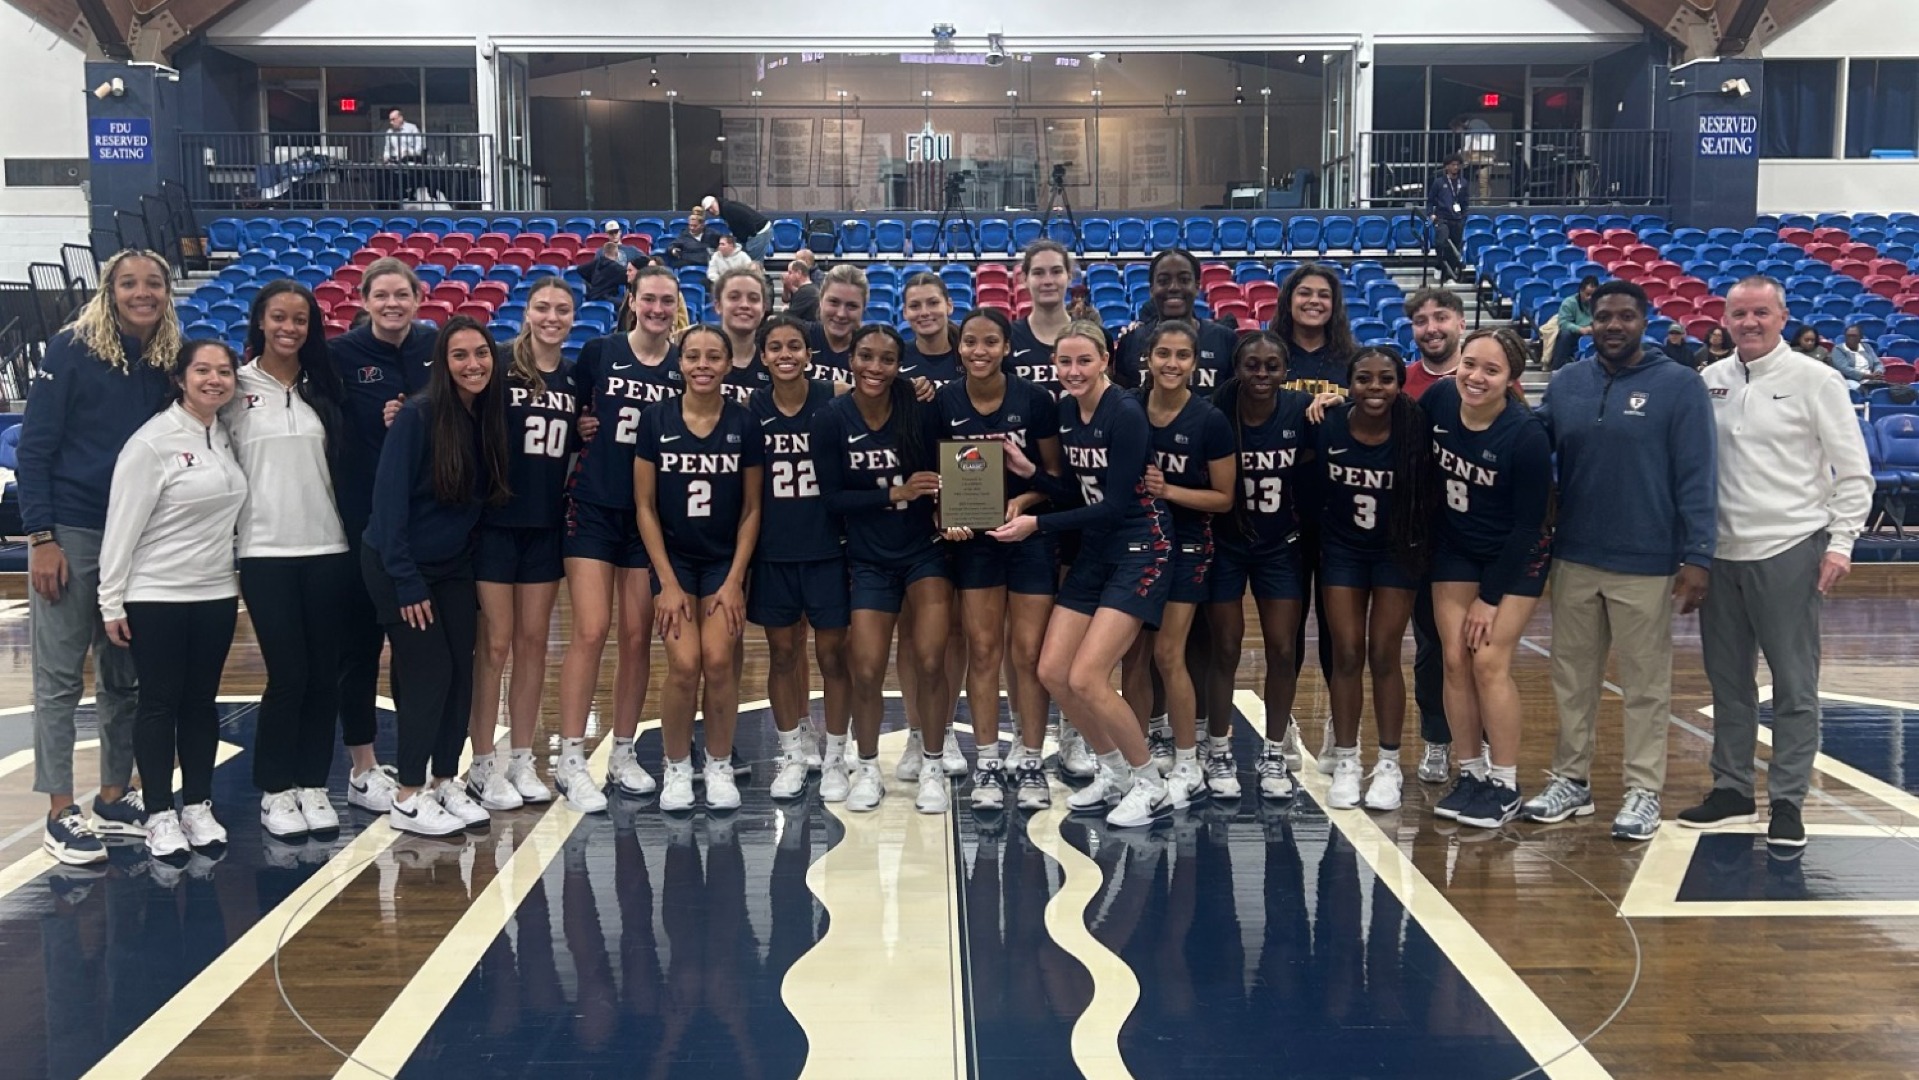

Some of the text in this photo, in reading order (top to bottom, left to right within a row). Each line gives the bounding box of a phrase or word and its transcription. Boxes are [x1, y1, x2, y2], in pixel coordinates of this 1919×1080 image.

[109, 122, 131, 133] FDU
[1699, 115, 1757, 133] RESERVED
[95, 134, 148, 146] RESERVED
[906, 130, 952, 162] FDU
[1701, 136, 1752, 155] SEATING
[99, 147, 144, 159] SEATING
[524, 415, 568, 458] 20
[660, 452, 741, 474] PENN
[1241, 448, 1297, 470] ENN
[772, 460, 820, 498] 22
[687, 480, 712, 517] 2
[1446, 479, 1469, 513] 8
[1353, 494, 1377, 530] 3
